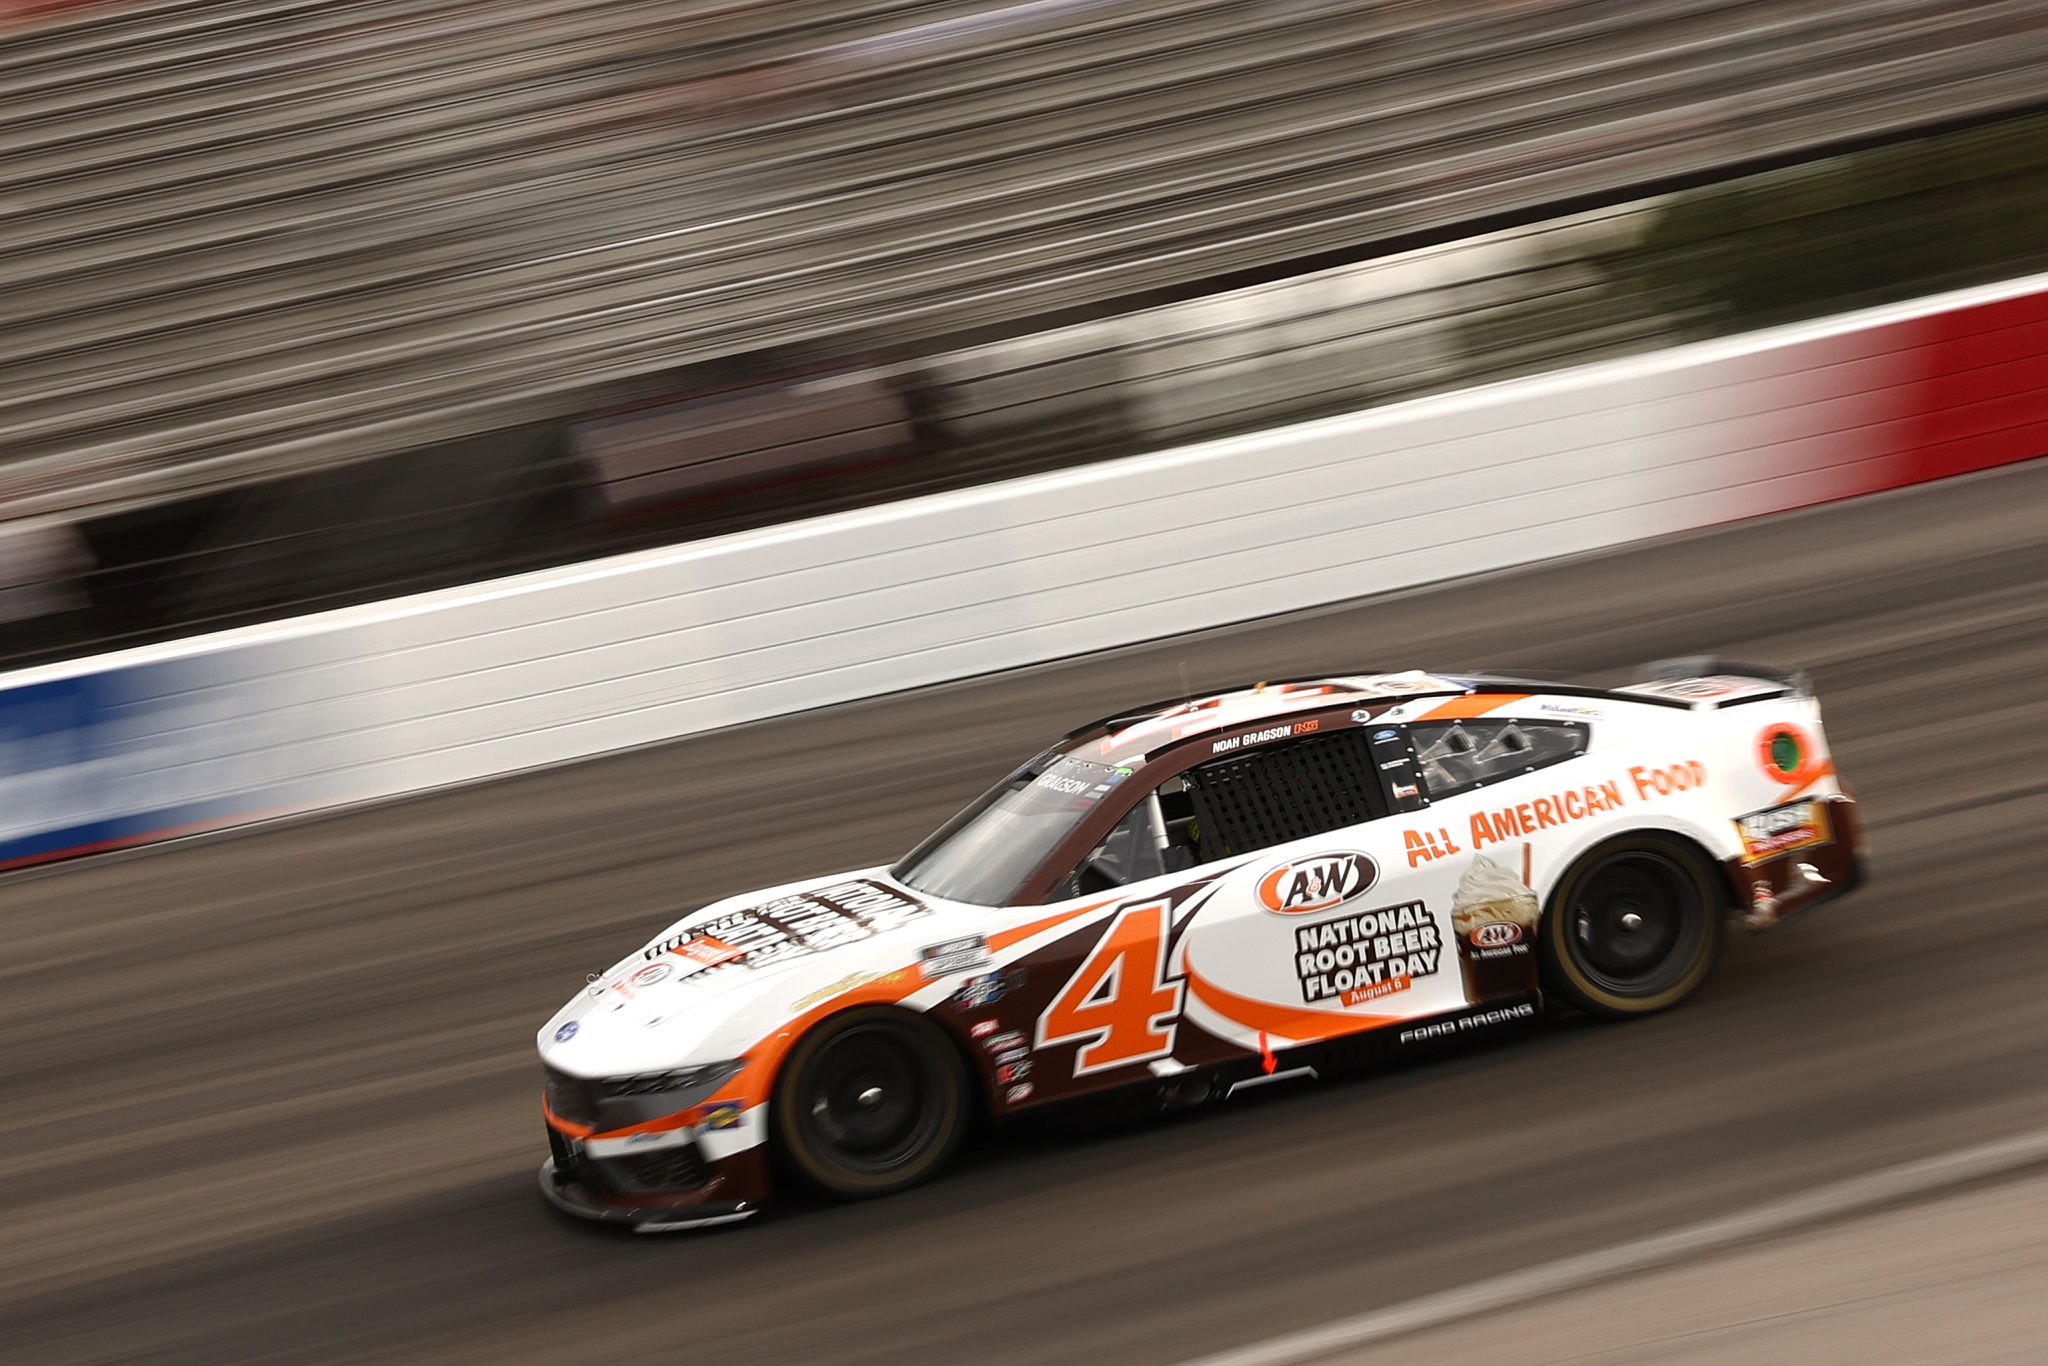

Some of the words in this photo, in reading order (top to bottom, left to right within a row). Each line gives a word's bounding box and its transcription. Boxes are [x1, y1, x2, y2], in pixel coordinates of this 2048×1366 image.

[1212, 739, 1240, 753] NOAH
[1242, 724, 1292, 746] GRAGSON
[1037, 773, 1091, 795] GRAGSON
[1403, 828, 1461, 868] ALL
[1469, 780, 1625, 850] AMERICAN
[1629, 760, 1706, 800] FOOD
[1283, 854, 1357, 909] A&W
[1299, 903, 1431, 951] NATIONAL
[1300, 941, 1369, 979] ROOT
[1373, 925, 1438, 960] BEER
[1034, 898, 1185, 1077] 4
[1305, 961, 1385, 1001] FLOAT
[1388, 949, 1437, 980] DAY
[1351, 981, 1391, 1004] August
[1394, 978, 1402, 990] 6
[1400, 1021, 1457, 1044] FORD
[1458, 1003, 1535, 1031] RACING
